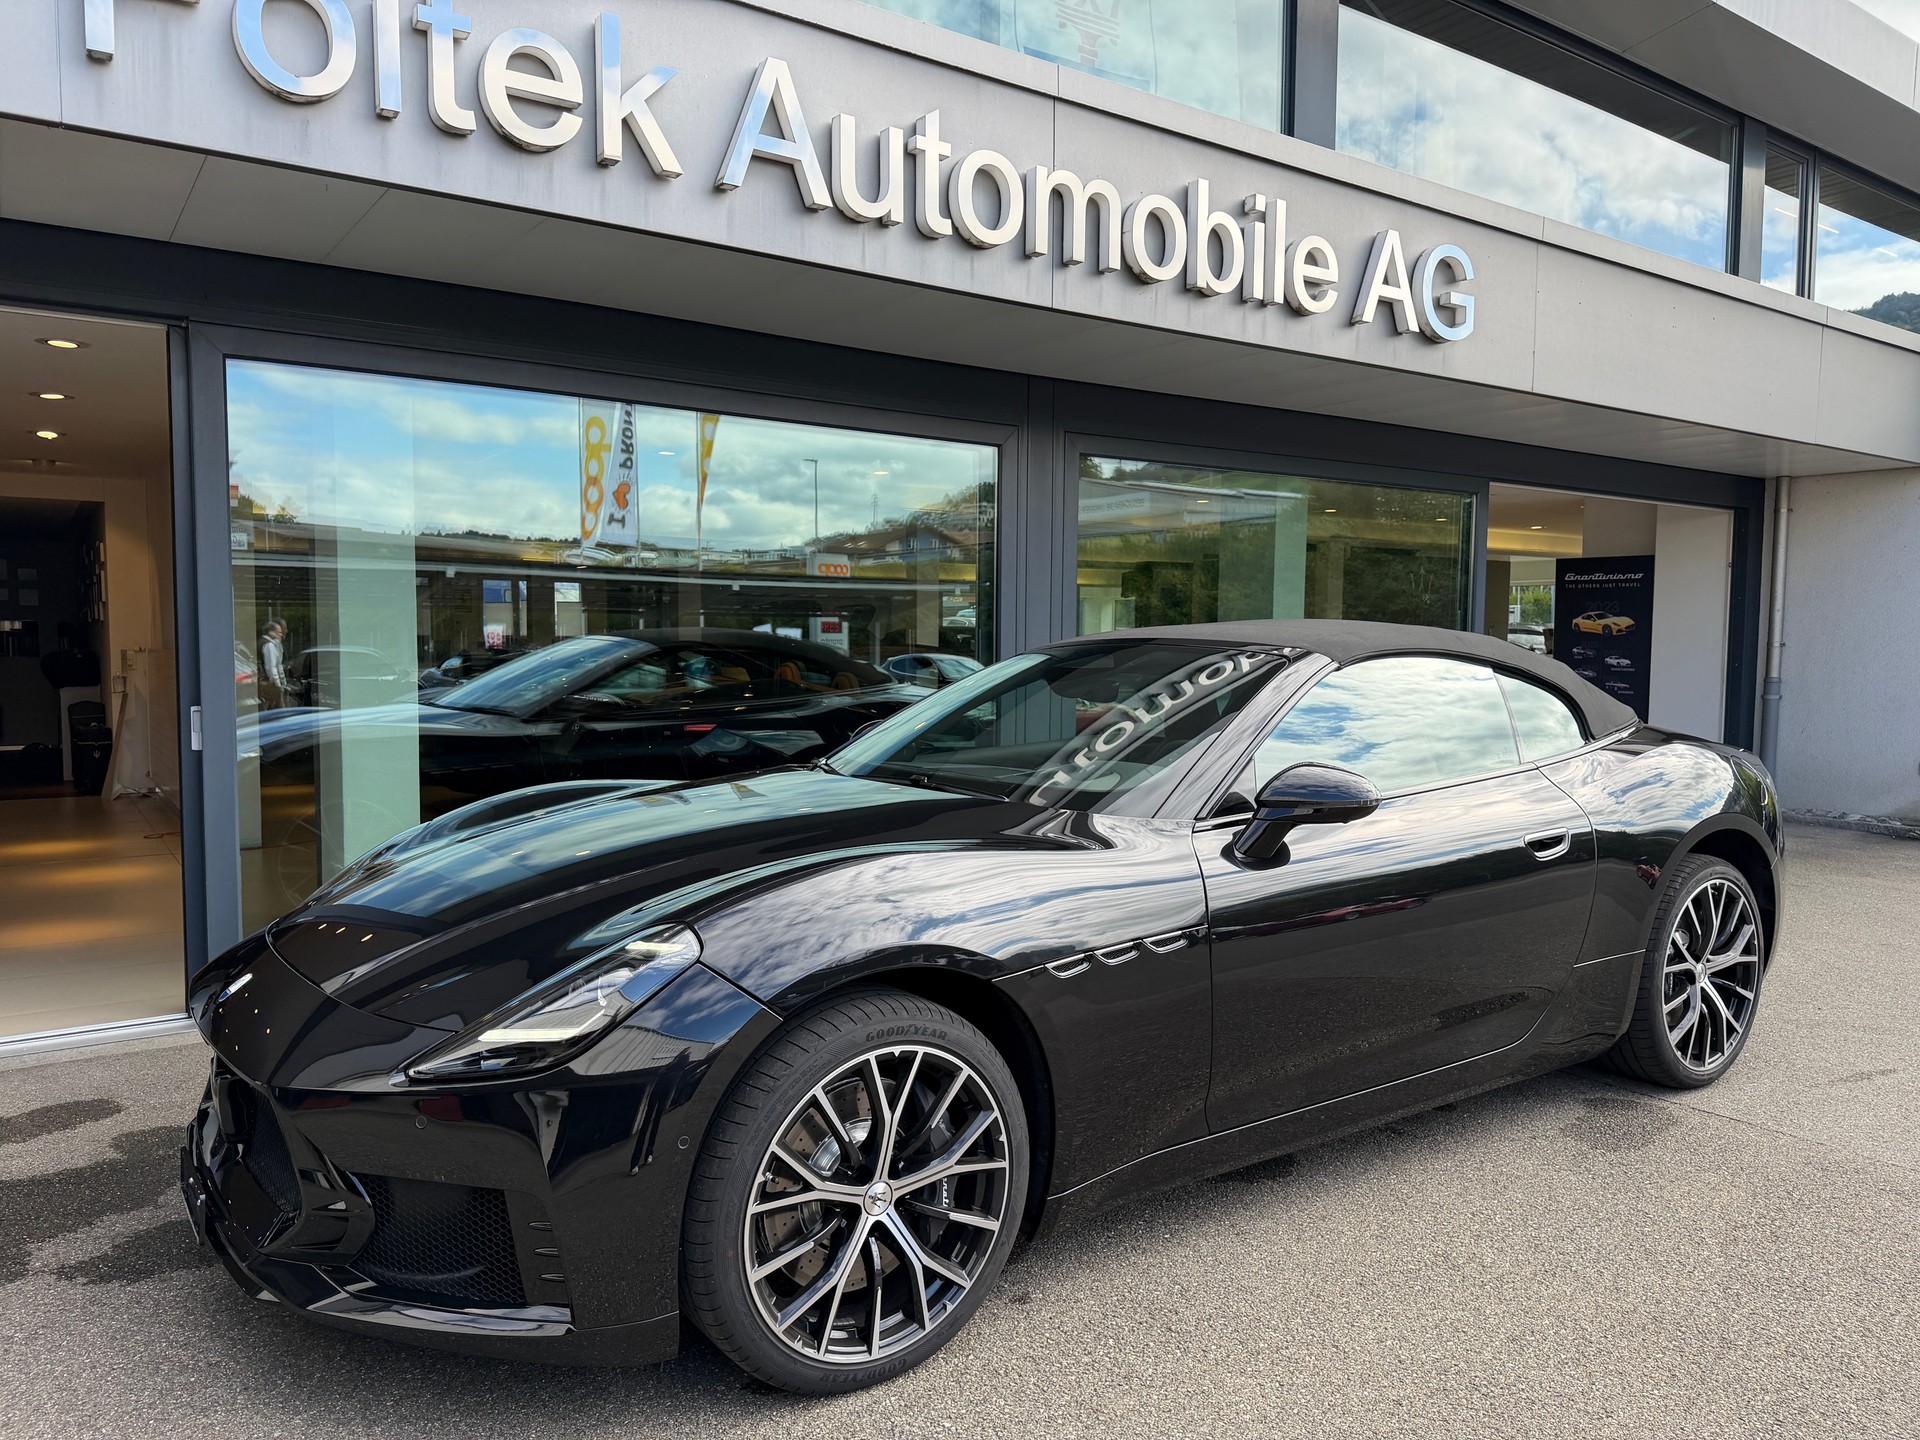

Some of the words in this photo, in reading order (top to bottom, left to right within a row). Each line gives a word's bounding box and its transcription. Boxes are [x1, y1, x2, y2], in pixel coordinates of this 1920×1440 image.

[714, 57, 1339, 316] Automobile
[1351, 229, 1476, 343] AG
[1564, 572, 1644, 581] GranTurismo
